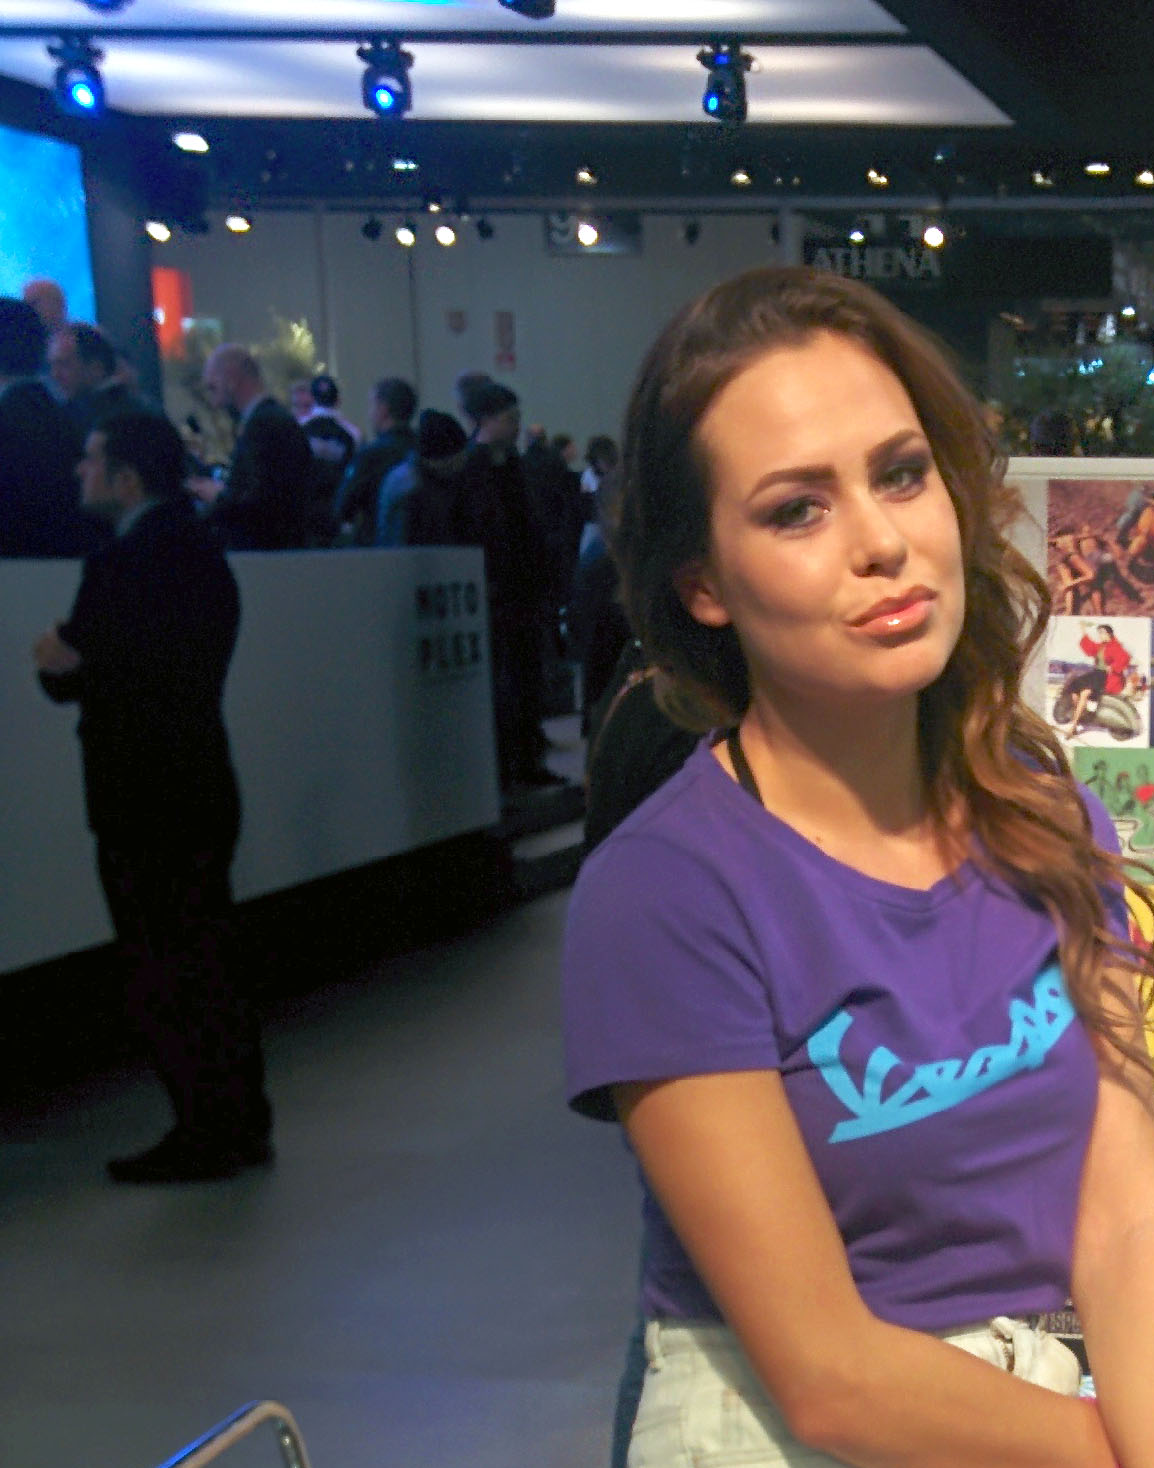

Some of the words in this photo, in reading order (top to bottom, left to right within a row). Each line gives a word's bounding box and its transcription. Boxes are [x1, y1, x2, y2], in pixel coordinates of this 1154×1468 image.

[813, 248, 942, 277] ATHENA
[416, 582, 479, 618] MOTO
[419, 631, 481, 669] PLEX
[807, 963, 1077, 1144] Vespa
